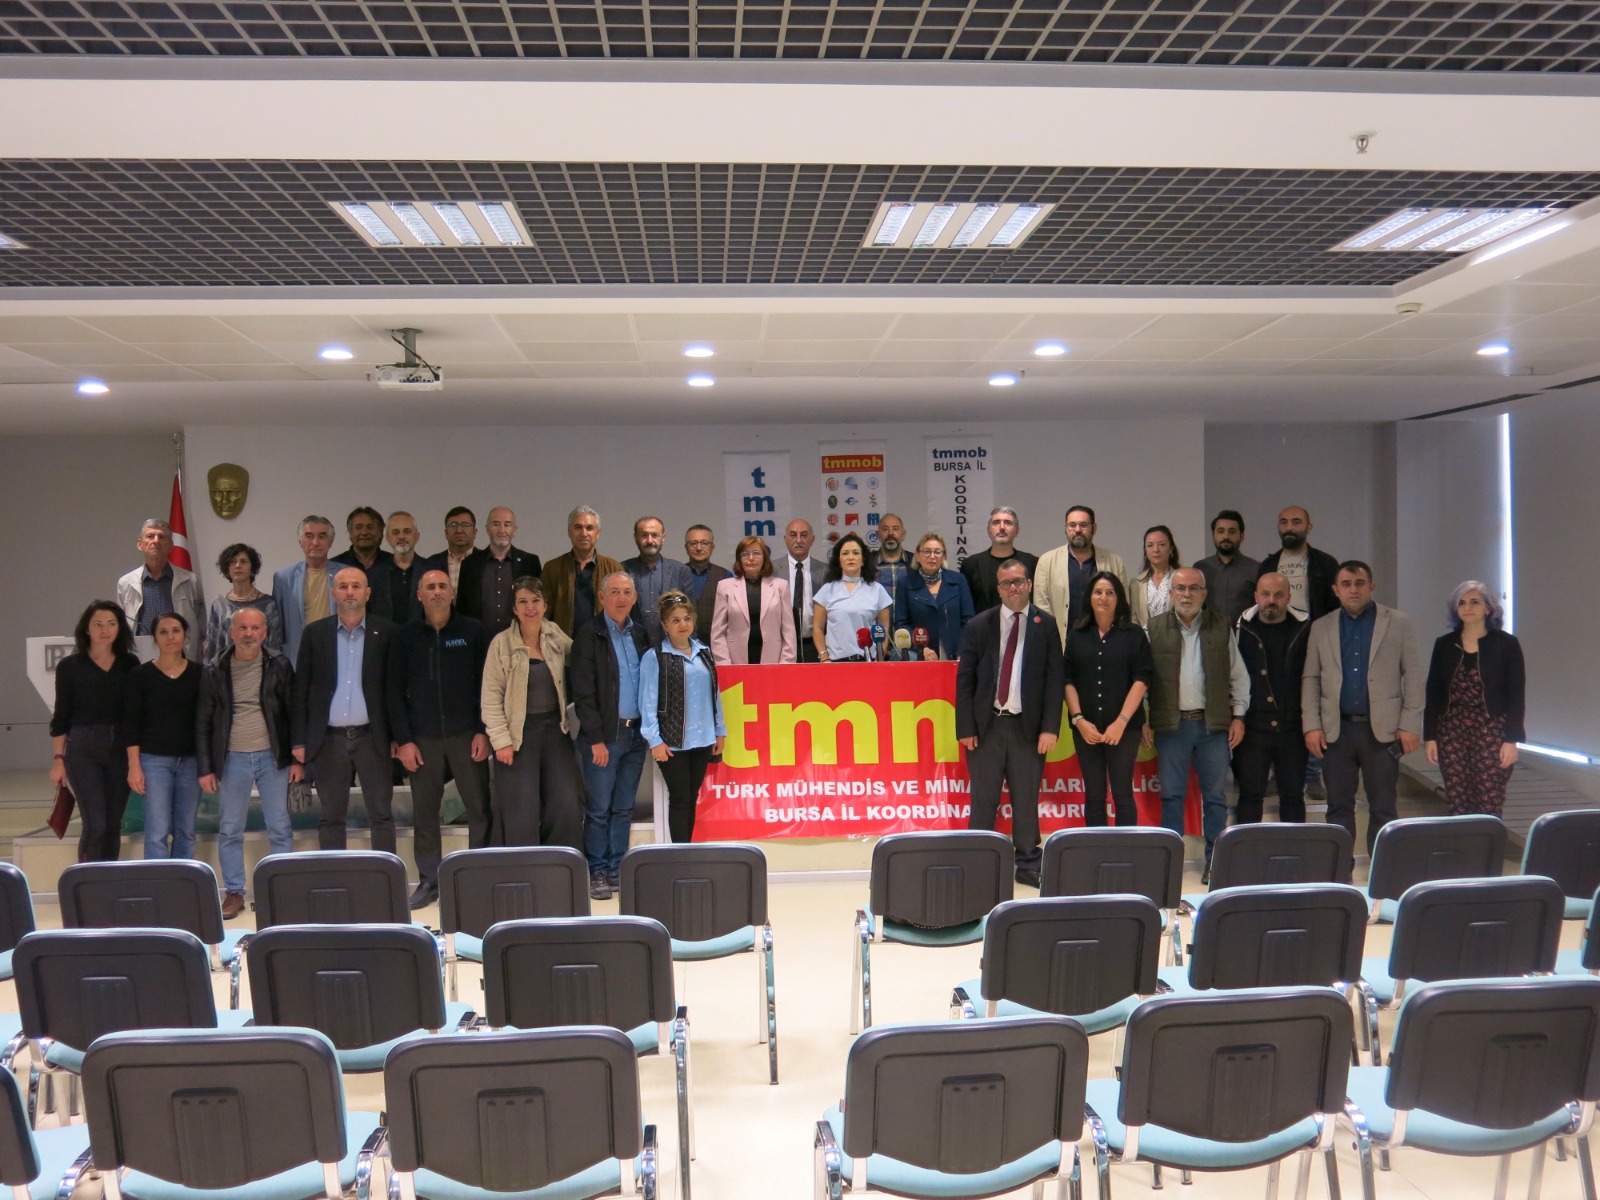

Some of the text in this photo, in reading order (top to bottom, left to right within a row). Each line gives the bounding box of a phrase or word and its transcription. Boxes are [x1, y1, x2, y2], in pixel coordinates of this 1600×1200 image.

[932, 447, 987, 459] tmmob
[824, 456, 882, 469] tmmob
[934, 462, 971, 471] BURSA
[955, 475, 967, 571] KOORDİNAS
[712, 782, 770, 799] TÜRK
[776, 778, 886, 798] MÜHENDİS
[891, 780, 919, 795] VE
[765, 805, 836, 823] BURSA
[841, 803, 860, 821] İL
